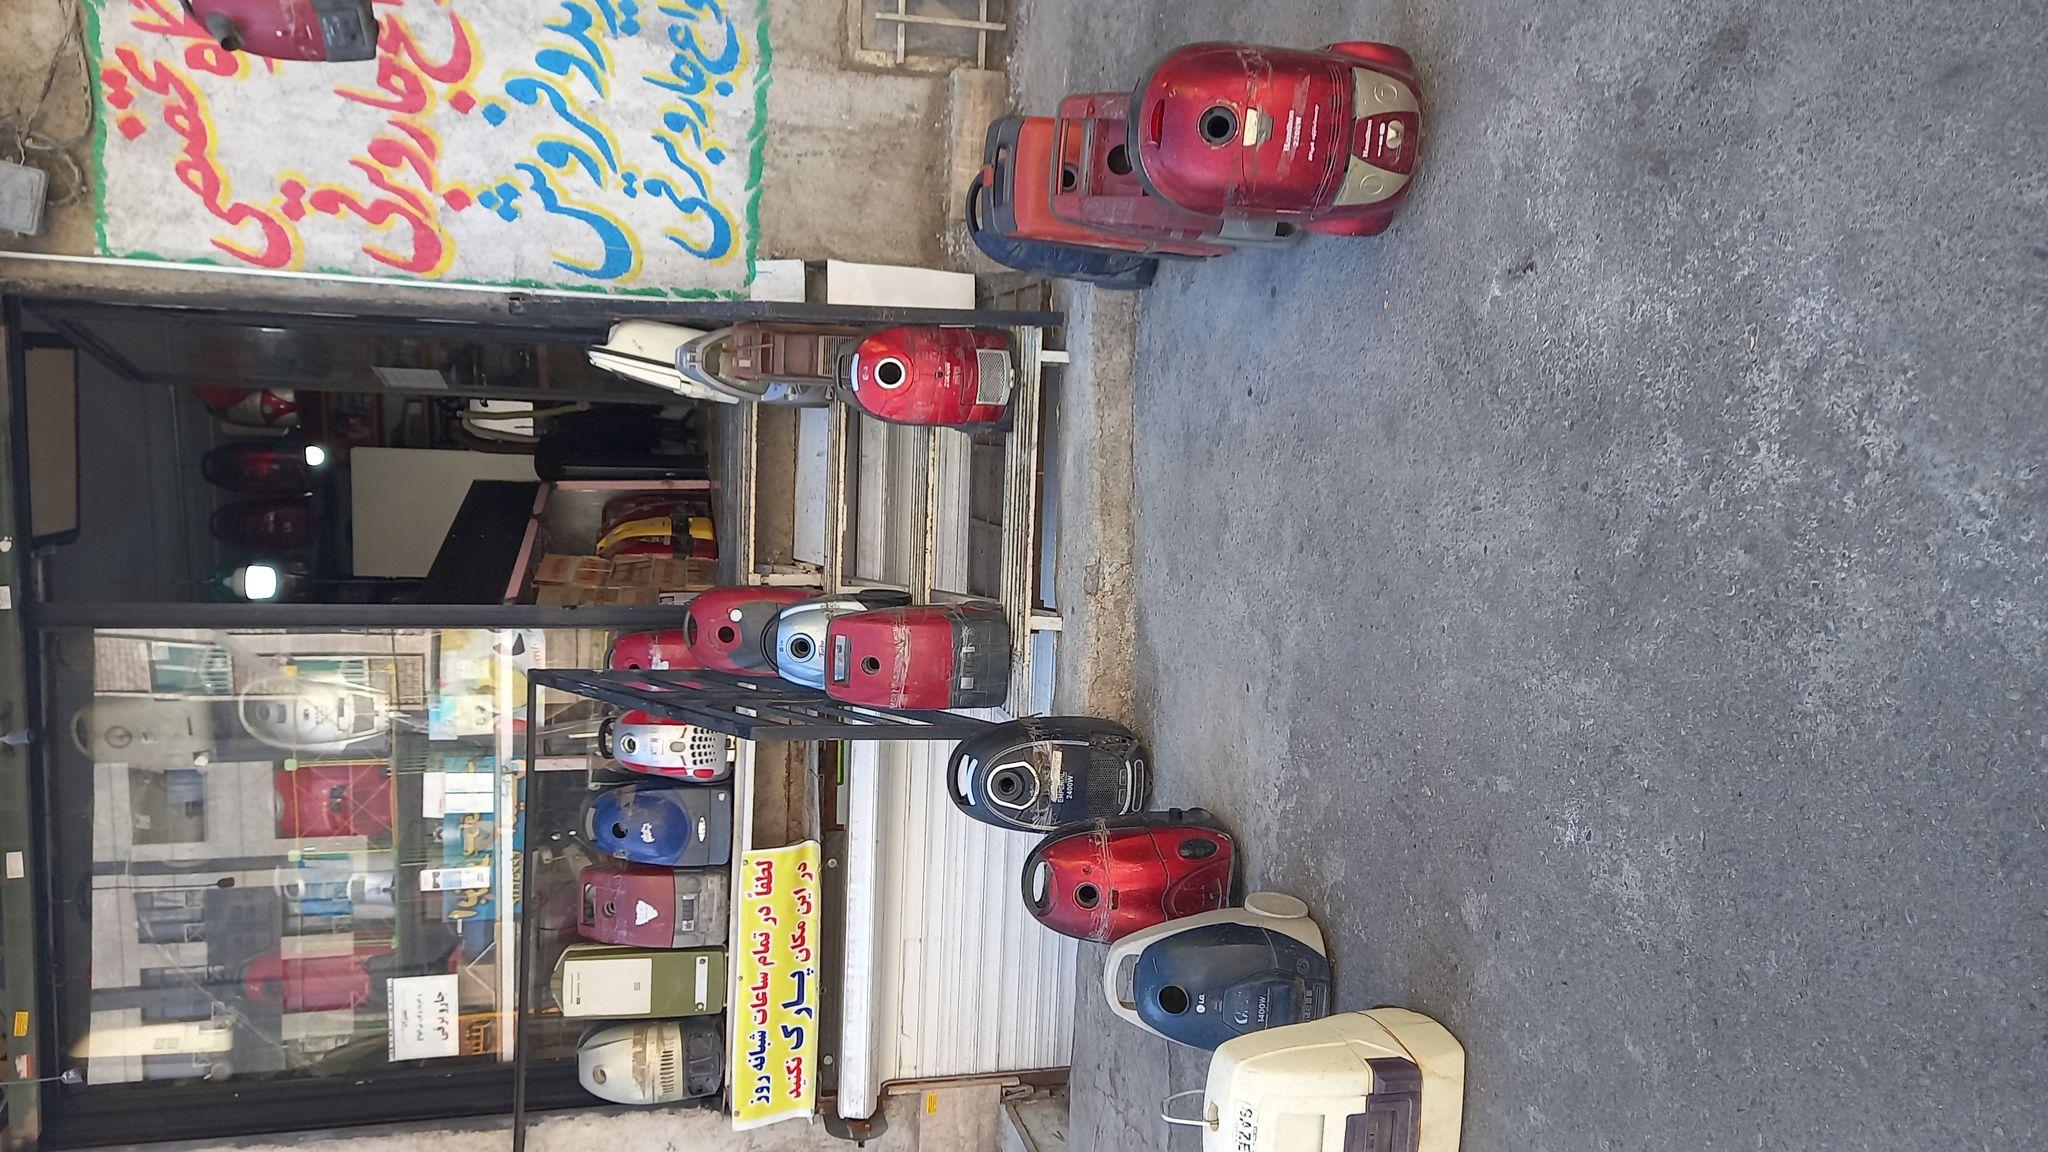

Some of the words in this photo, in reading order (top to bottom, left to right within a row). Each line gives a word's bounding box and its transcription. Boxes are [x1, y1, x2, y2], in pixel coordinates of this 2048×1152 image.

[1282, 109, 1295, 152] Hamilton
[1362, 119, 1373, 158] Hamilton
[1066, 775, 1074, 799] 2400W
[795, 862, 814, 881] در
[758, 906, 777, 926] در
[792, 888, 812, 915] این
[752, 932, 775, 967] تمام
[790, 921, 811, 962] مکان
[750, 972, 770, 1025] ساعات
[1257, 995, 1266, 1022] 1400W
[786, 1057, 807, 1099] نکنید
